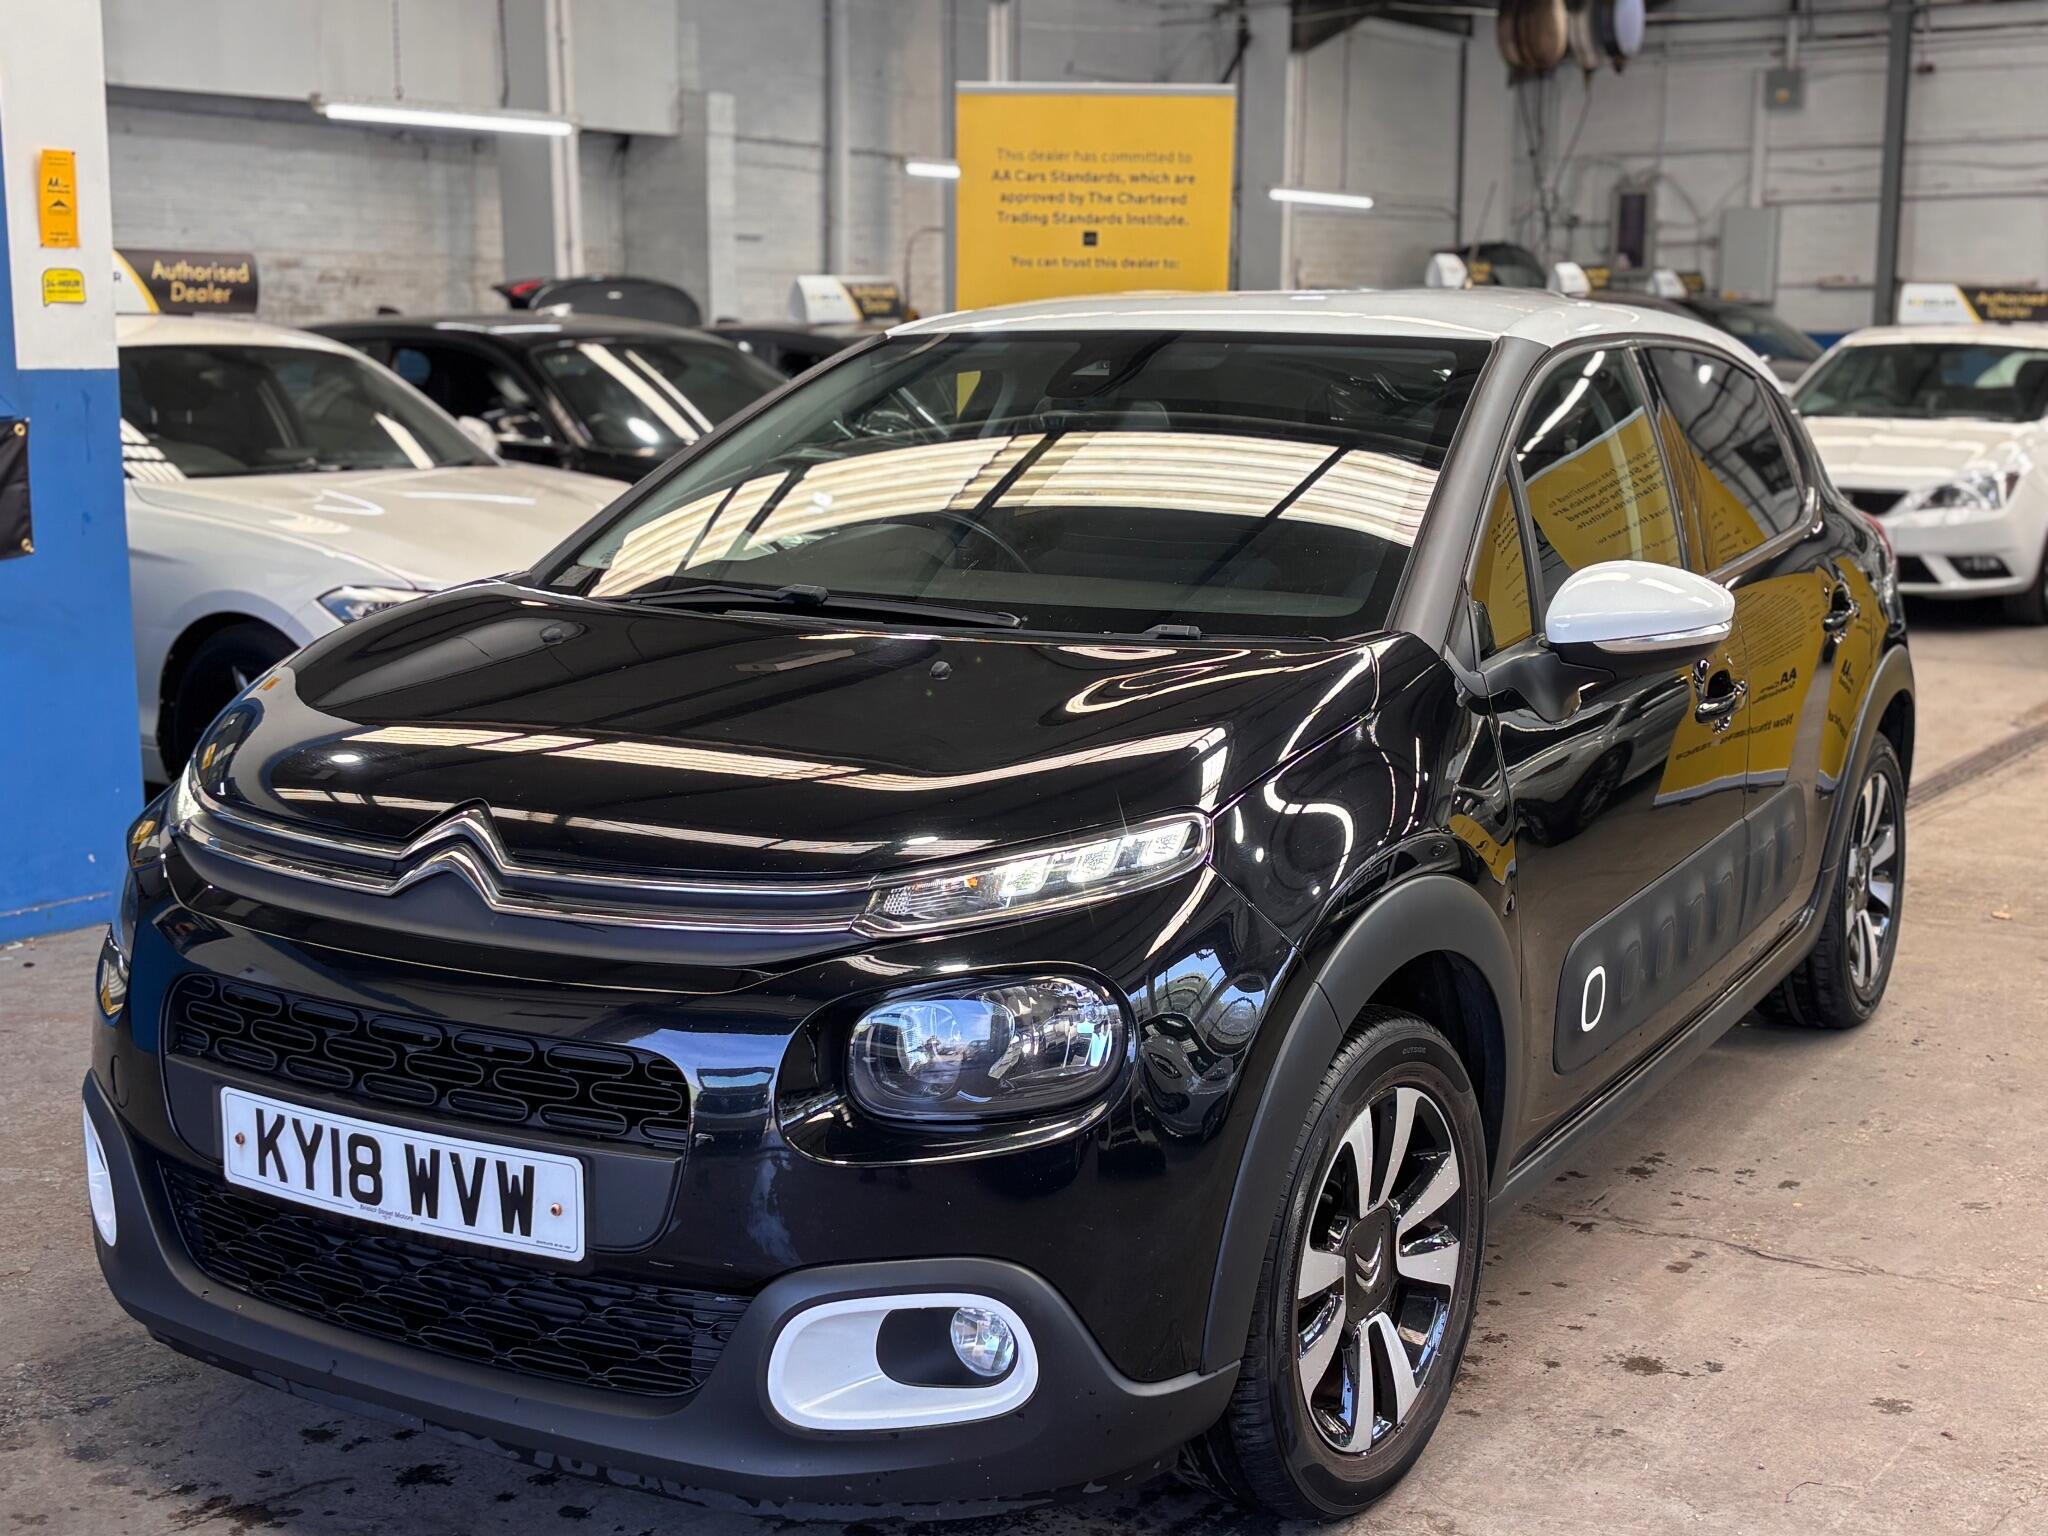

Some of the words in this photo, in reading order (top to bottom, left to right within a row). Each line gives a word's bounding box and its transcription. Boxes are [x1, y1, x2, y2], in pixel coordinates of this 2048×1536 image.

[998, 148, 1024, 161] This
[1028, 149, 1070, 162] dealer
[1073, 150, 1098, 163] has
[1102, 152, 1175, 163] committed
[1178, 152, 1192, 163] to
[992, 170, 1011, 181] AA
[1014, 170, 1046, 182] Cars
[1051, 171, 1126, 184] Standards,
[1129, 172, 1170, 183] which
[1174, 174, 1195, 184] are
[1000, 191, 1065, 205] approved
[1068, 192, 1084, 206] by
[1088, 192, 1113, 204] The
[1117, 193, 1187, 205] Chartered
[997, 211, 1048, 226] Trading
[1053, 211, 1122, 225] Standards
[1126, 212, 1190, 226] Institute.
[1010, 256, 1032, 267] You
[1037, 257, 1059, 268] can
[1062, 257, 1091, 268] trust
[1094, 256, 1117, 268] this
[1121, 257, 1159, 269] dealer
[151, 259, 249, 283] Authorised
[170, 281, 232, 304] Dealer
[255, 1108, 383, 1206] KY18
[404, 1143, 536, 1238] WVW
[394, 1211, 414, 1222] Motors
